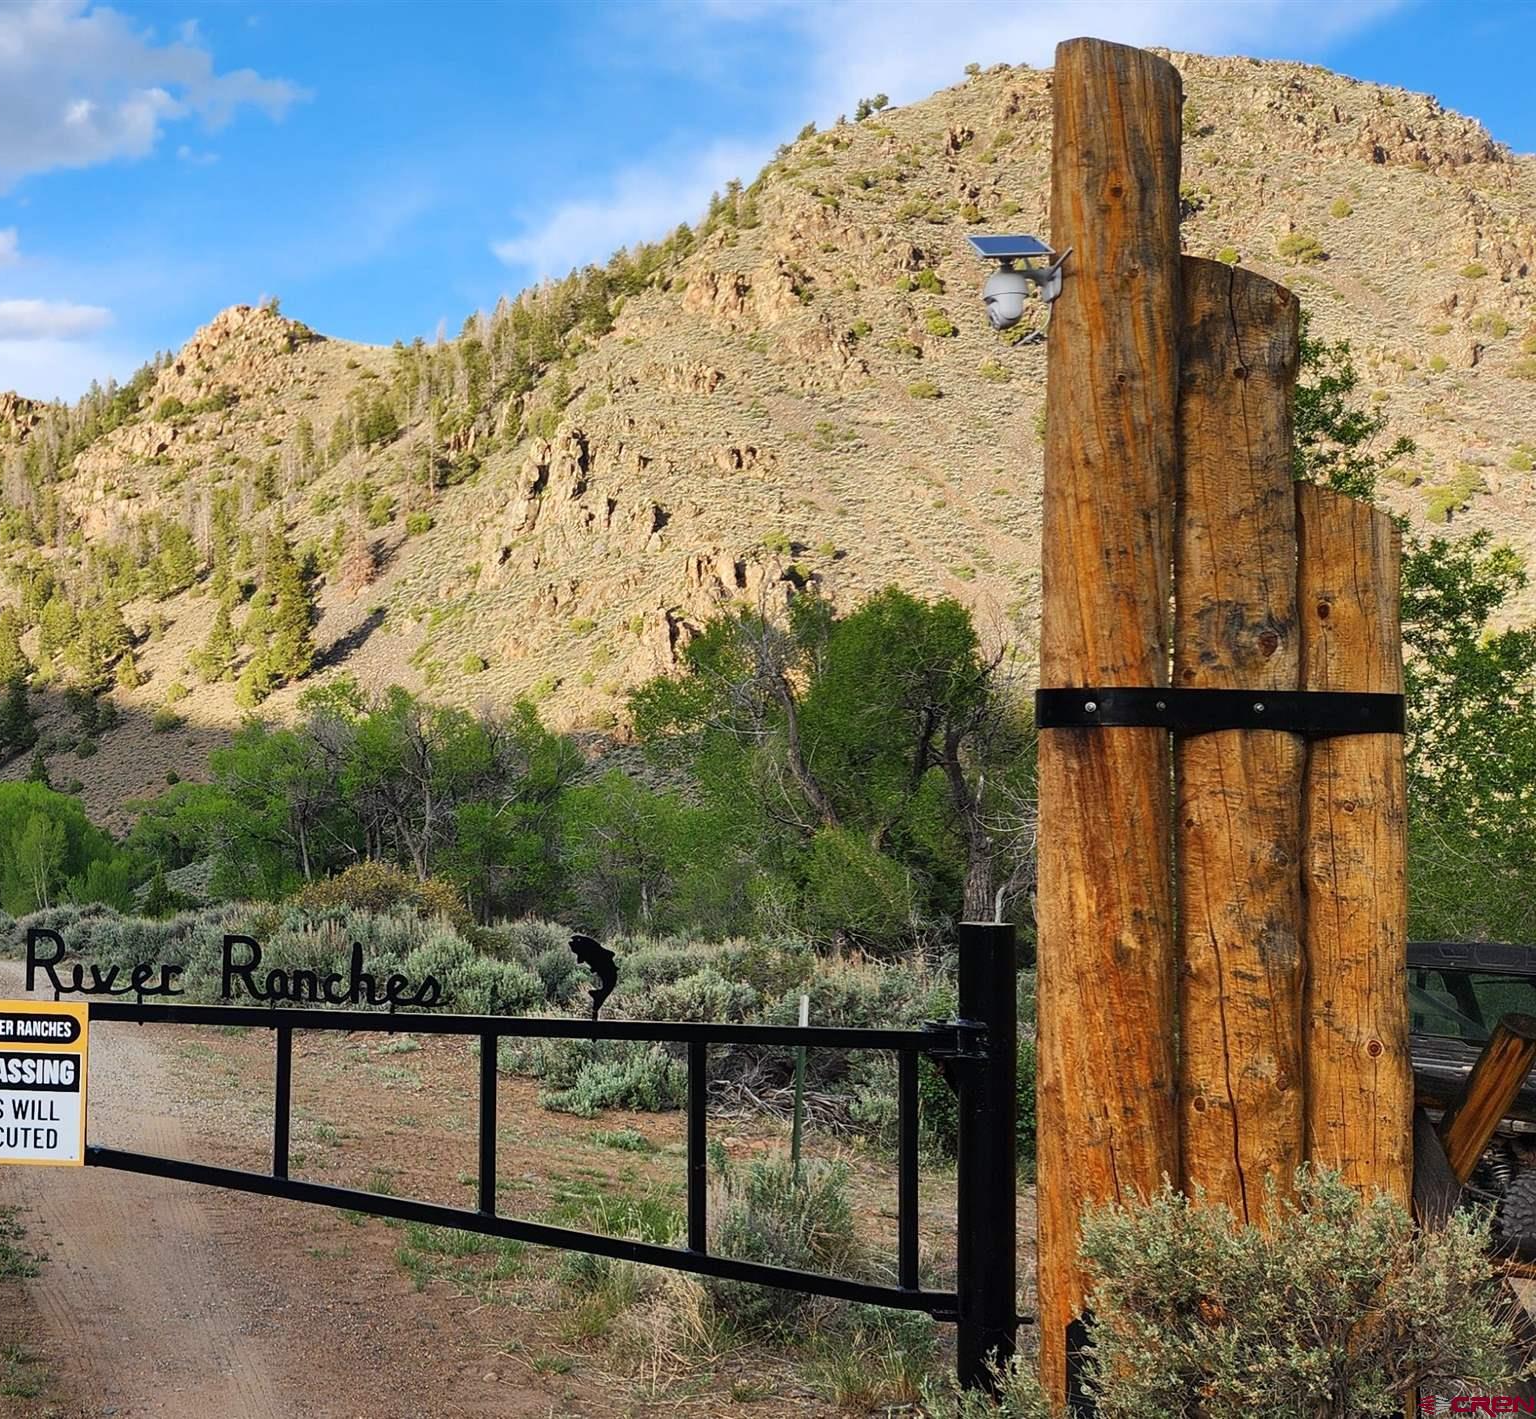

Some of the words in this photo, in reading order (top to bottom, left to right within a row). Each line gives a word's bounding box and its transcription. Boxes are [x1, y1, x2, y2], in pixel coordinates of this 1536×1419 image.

[25, 928, 186, 997] River
[221, 934, 447, 1007] Ranches
[16, 1020, 72, 1038] RANCHES
[12, 1099, 61, 1121] WILL
